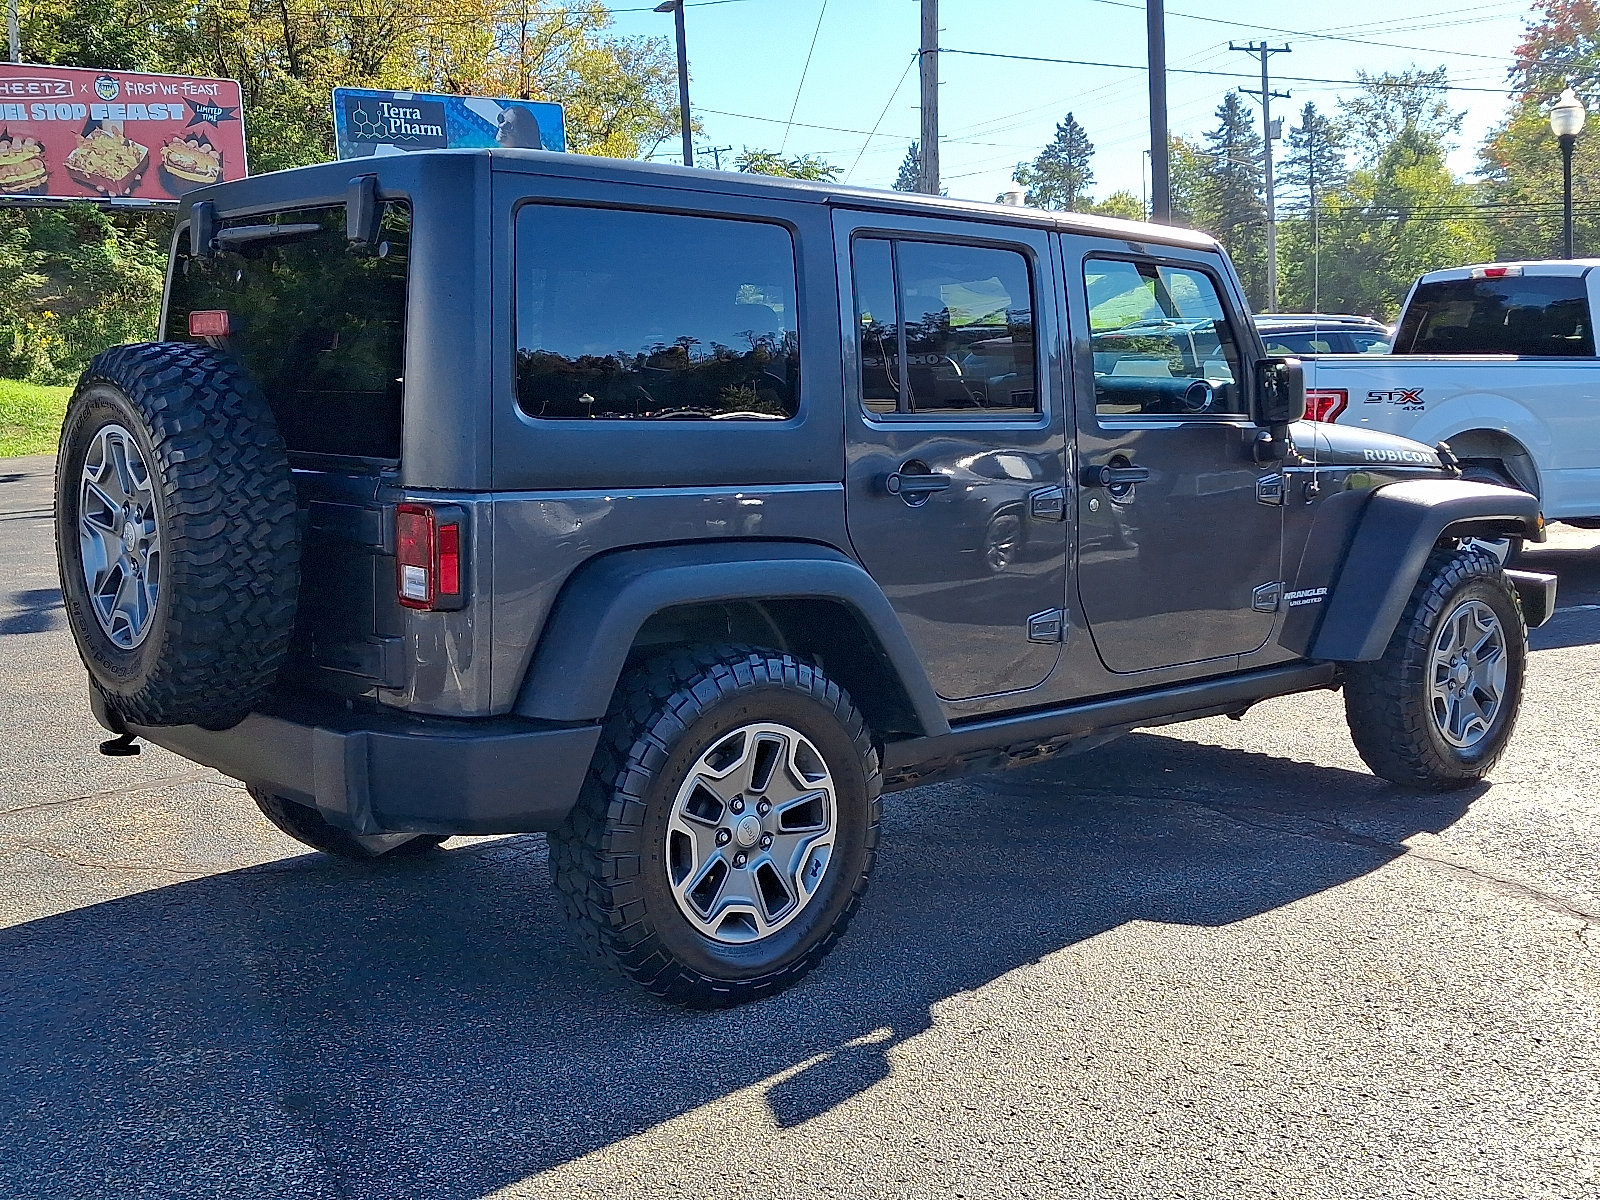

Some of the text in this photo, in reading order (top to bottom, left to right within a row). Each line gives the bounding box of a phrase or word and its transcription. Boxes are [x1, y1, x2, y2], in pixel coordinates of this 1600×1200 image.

[125, 81, 158, 96] FIRST
[159, 82, 178, 96] WE
[180, 82, 219, 96] FEAST
[31, 103, 87, 120] STOP
[90, 103, 184, 120] FEAST
[196, 105, 223, 116] LIMITED
[202, 112, 217, 122] TIME
[379, 102, 421, 120] Terra
[389, 117, 443, 137] Pharm
[1364, 388, 1425, 405] STX
[1363, 448, 1434, 463] RUBICON
[1283, 587, 1328, 600] WRANGLER
